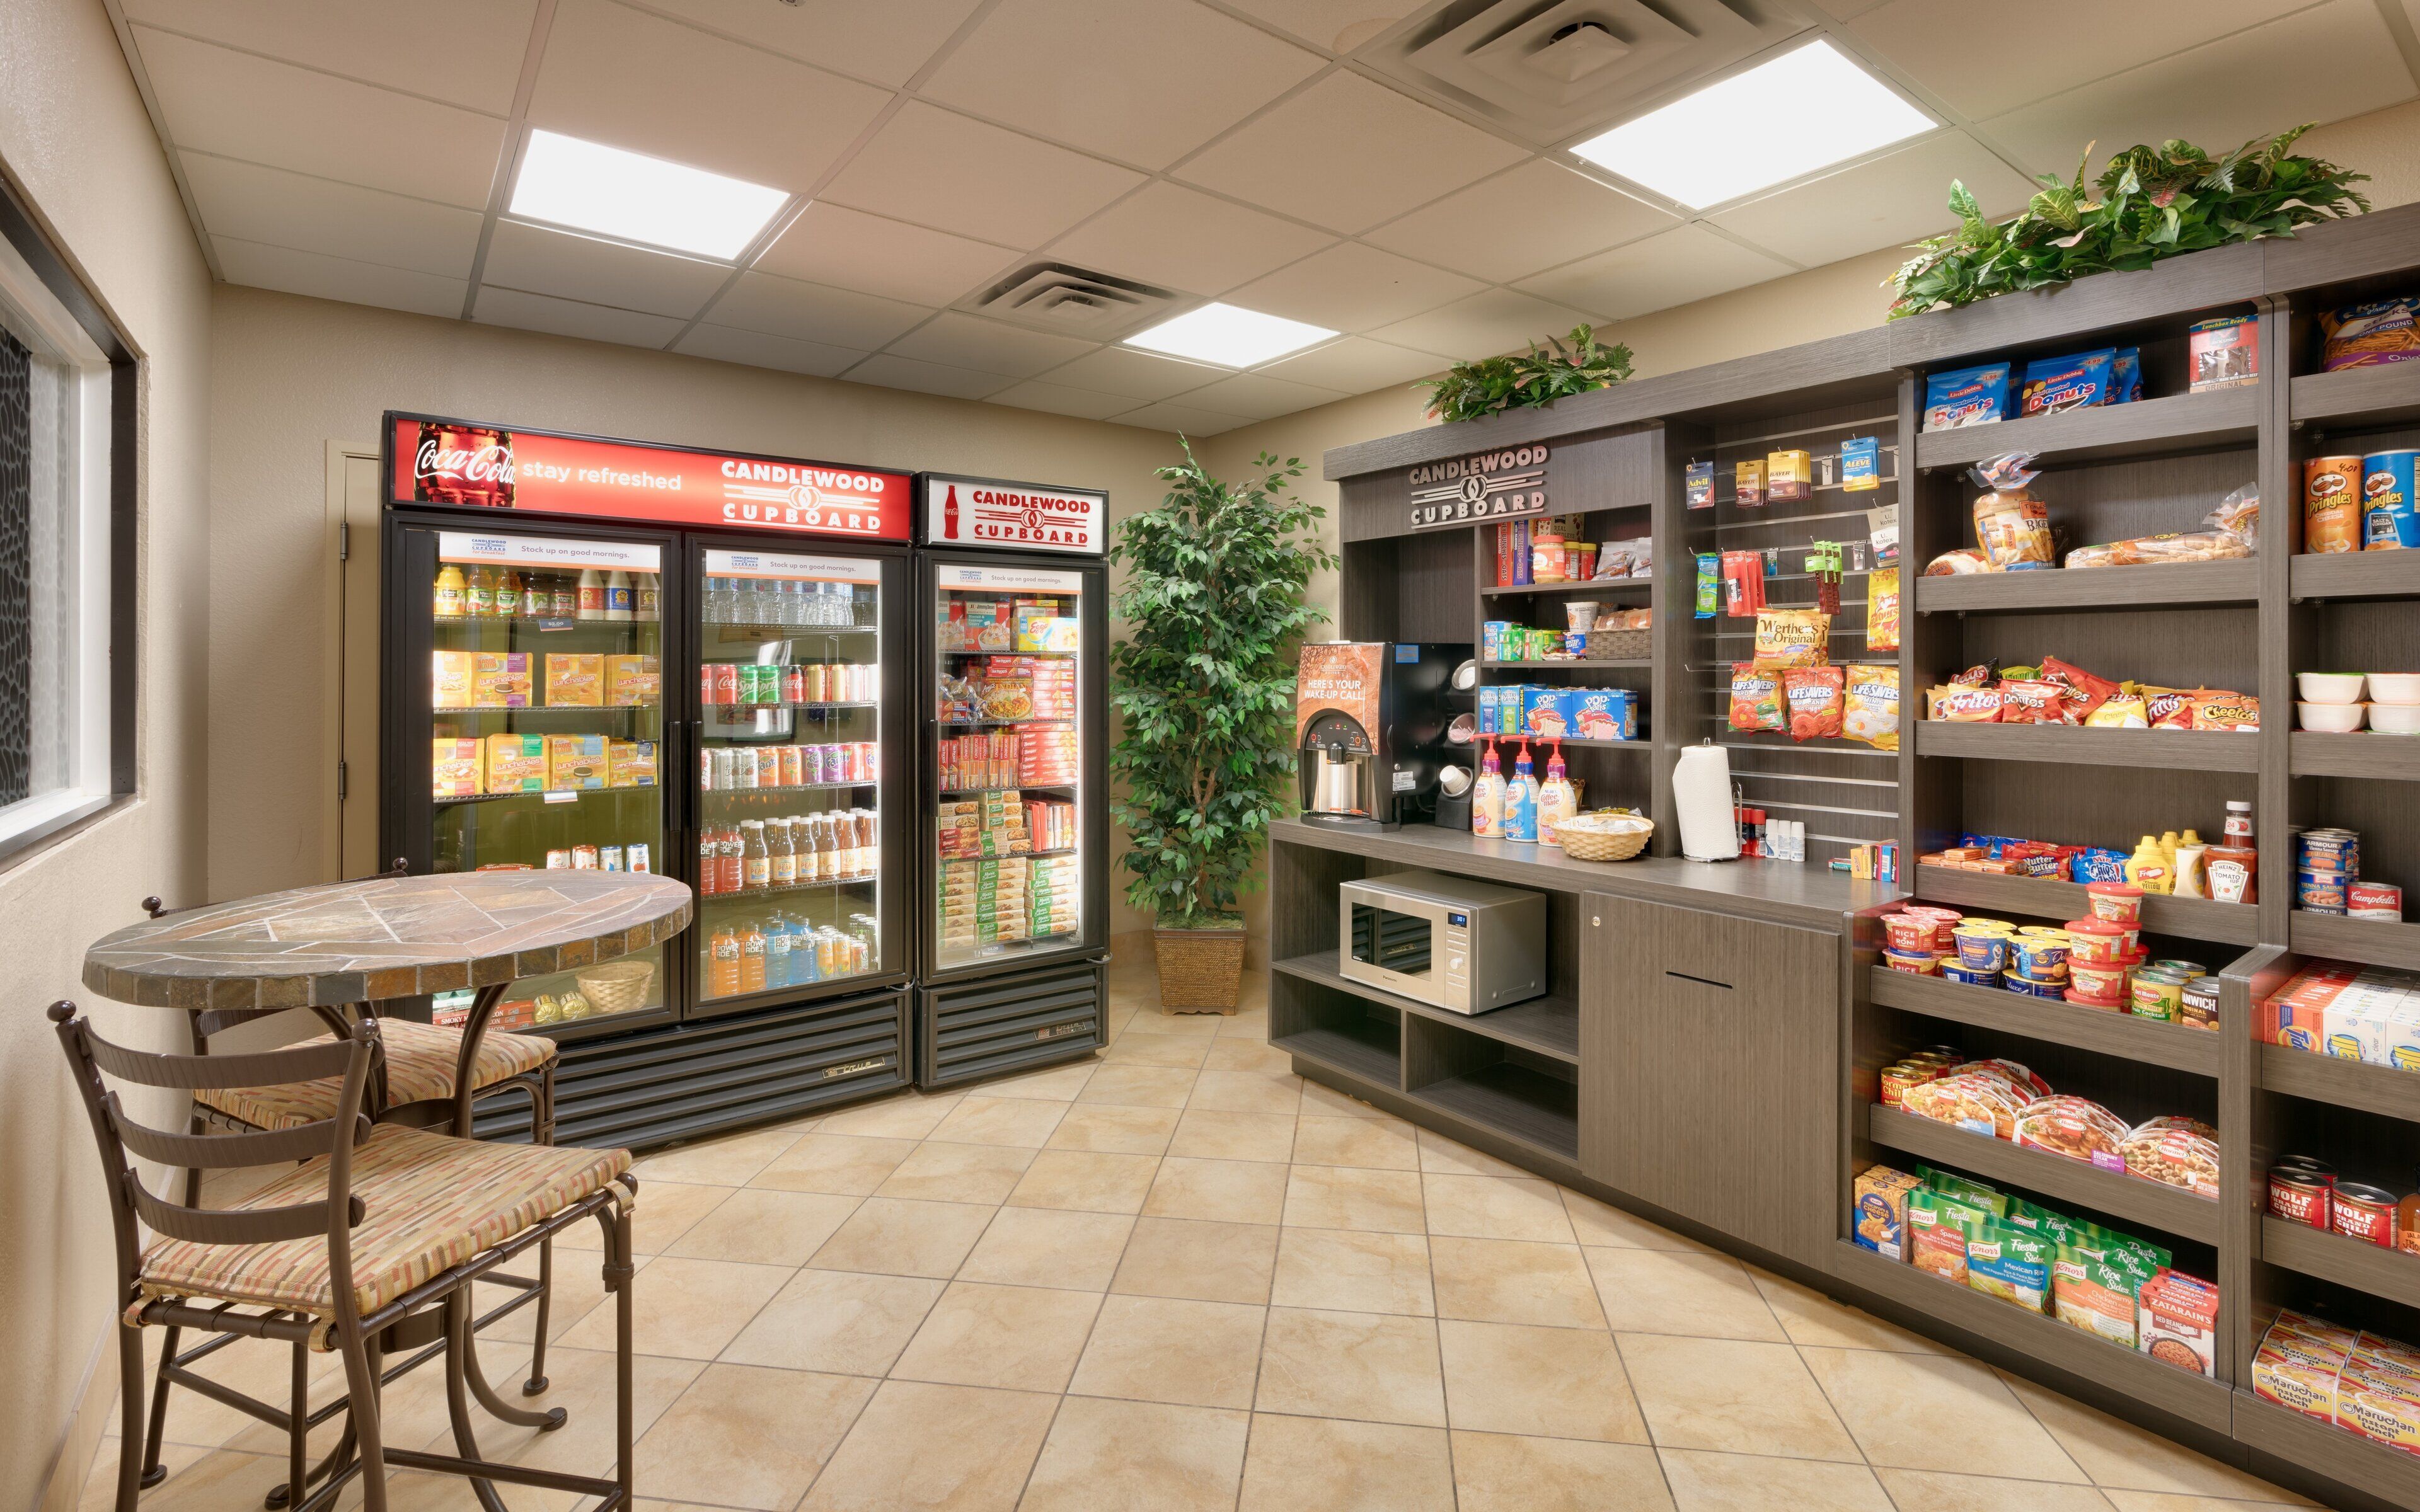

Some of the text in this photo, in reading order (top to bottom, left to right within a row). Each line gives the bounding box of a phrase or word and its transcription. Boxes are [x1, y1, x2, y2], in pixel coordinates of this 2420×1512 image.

[2202, 321, 2229, 330] Lunchbox
[2359, 320, 2413, 337] ONE POUND
[2046, 370, 2083, 384] Little Debbie
[1949, 384, 1982, 398] Little Debbie
[2032, 382, 2070, 398] Mini Frosted
[2206, 381, 2244, 391] ORIGINAL
[1936, 396, 1978, 411] Mini Powdered
[2029, 382, 2095, 411] Donuts
[1933, 397, 1994, 425] Donuts
[414, 440, 516, 486] Coca-Cola
[1409, 445, 1548, 485] CANDLEWOOD
[1843, 459, 1871, 469] ALEVE
[522, 461, 682, 491] stay refreshed
[721, 461, 885, 493] CANDLEWOOD
[1688, 477, 1708, 488] Advil
[972, 490, 1092, 515] CANDLEWOOD
[1410, 491, 1545, 525] CUPBOARD
[2308, 491, 2352, 518] Pringles
[723, 502, 882, 530] CUPBOARD
[1880, 517, 1897, 526] kotex
[974, 524, 1089, 545] CUPBOARD
[521, 545, 544, 554] Stock
[546, 547, 556, 556] up
[570, 546, 591, 558] good
[592, 548, 630, 559] mornings.
[809, 562, 825, 571] good
[826, 564, 856, 573] mornings.
[1760, 619, 1819, 635] Werthe's
[1773, 632, 1816, 646] Original
[479, 673, 525, 686] Lunchables
[1308, 679, 1361, 690] HERE'S YOUR
[1304, 690, 1366, 701] WAKE-UP CALL.
[1862, 697, 1884, 705] MINTS
[1949, 692, 2000, 713] Fritos
[2004, 694, 2045, 708] Doritos
[2104, 709, 2133, 720] Classic
[2203, 705, 2258, 721] Cheetos
[495, 757, 540, 770] Lunchables
[2306, 840, 2337, 849] ARMOUR
[2025, 856, 2054, 866] Nutter
[2092, 856, 2112, 864] Mini
[2027, 862, 2058, 874] Butter
[2089, 862, 2114, 878] Chips
[2351, 891, 2397, 905] Campbell's
[2141, 990, 2160, 999] Monte
[441, 1016, 464, 1024] SMOKY
[2141, 1010, 2165, 1019] Cocktail
[2061, 1119, 2082, 1129] Hormel
[2093, 1150, 2118, 1161] SALISBURY
[2093, 1154, 2108, 1162] STEAK
[2270, 1184, 2312, 1208] WOLF
[1863, 1201, 1886, 1212] macaroni
[2273, 1196, 2307, 1211] BRAND
[2274, 1201, 2305, 1217] CHILI
[1909, 1211, 1935, 1222] Knorr
[1945, 1207, 1971, 1222] Fiesta
[2334, 1201, 2376, 1225] WOLF
[1940, 1228, 1964, 1242] Spanish
[1970, 1244, 1998, 1255] Knorr
[2010, 1239, 2038, 1253] Fiesta
[2127, 1241, 2157, 1260] Pasta
[2005, 1262, 2033, 1274] Mexican
[2055, 1263, 2085, 1278] Knorr
[2097, 1263, 2121, 1281] Rice
[2092, 1290, 2117, 1306] Chicken
[2104, 1290, 2131, 1305] Creamy
[2151, 1298, 2211, 1324] ZATARAIN'S
[2155, 1314, 2165, 1323] RED
[2285, 1360, 2309, 1371] Beef
[2269, 1375, 2327, 1403] Maruchan
[2274, 1385, 2313, 1404] Instant
[2278, 1392, 2308, 1409] Lunch
[2353, 1404, 2416, 1434] Maruchan
[2358, 1414, 2400, 1435] Instant
[2362, 1421, 2395, 1440] Lunch
